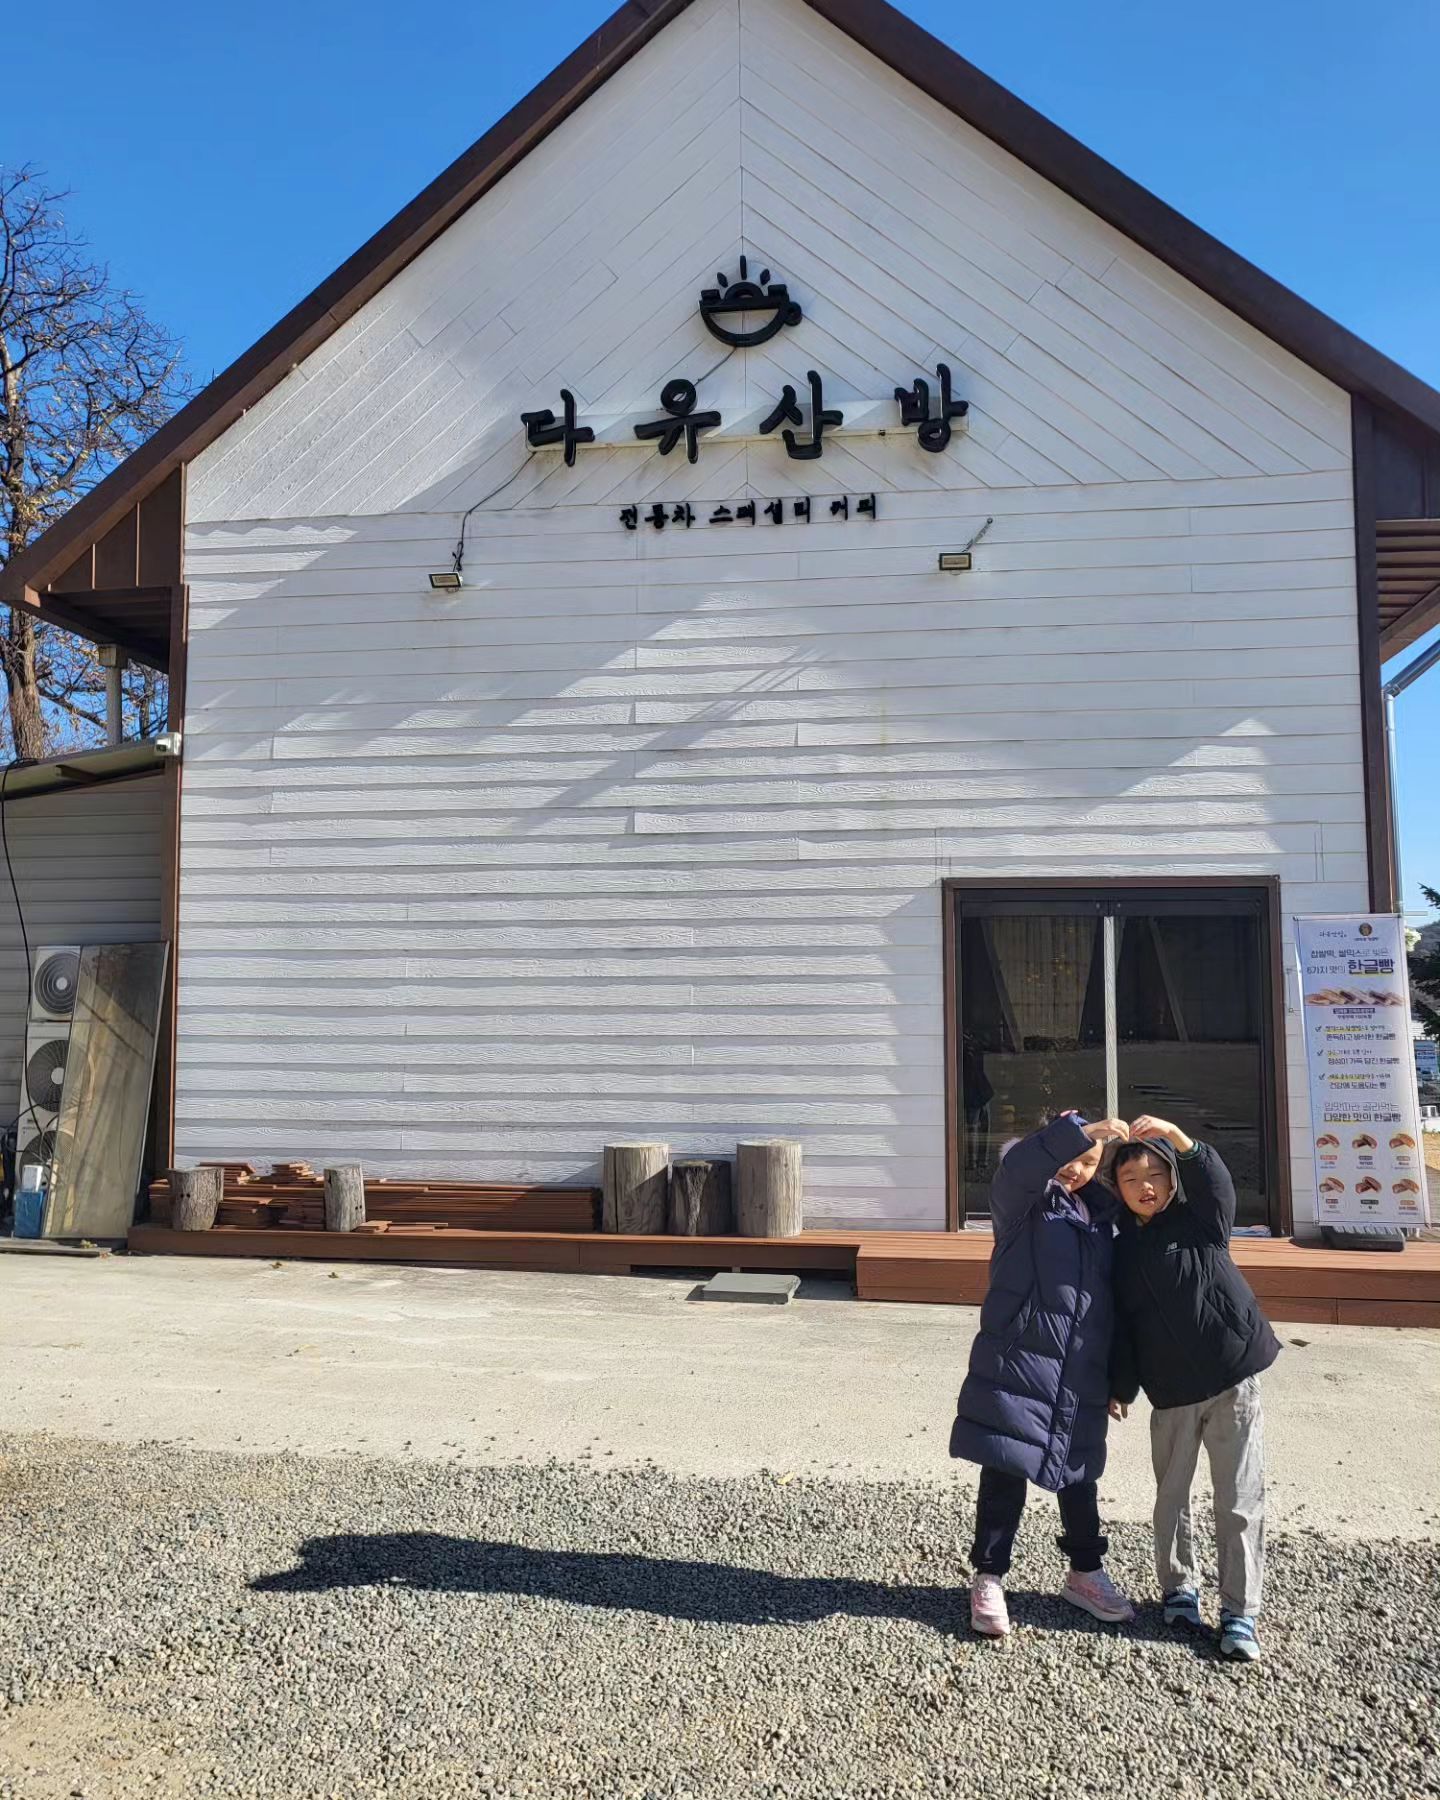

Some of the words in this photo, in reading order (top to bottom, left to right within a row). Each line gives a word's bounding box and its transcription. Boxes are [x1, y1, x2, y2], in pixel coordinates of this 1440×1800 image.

[520, 363, 969, 467] 다유산방
[619, 502, 696, 530] 전통차
[709, 495, 811, 526] 스페셜티
[830, 492, 877, 521] 커피
[1347, 959, 1395, 975] 한글빵
[1323, 1112, 1351, 1122] 다양한
[1352, 1112, 1372, 1122] 맛의
[1373, 1112, 1402, 1122] 한글빵
